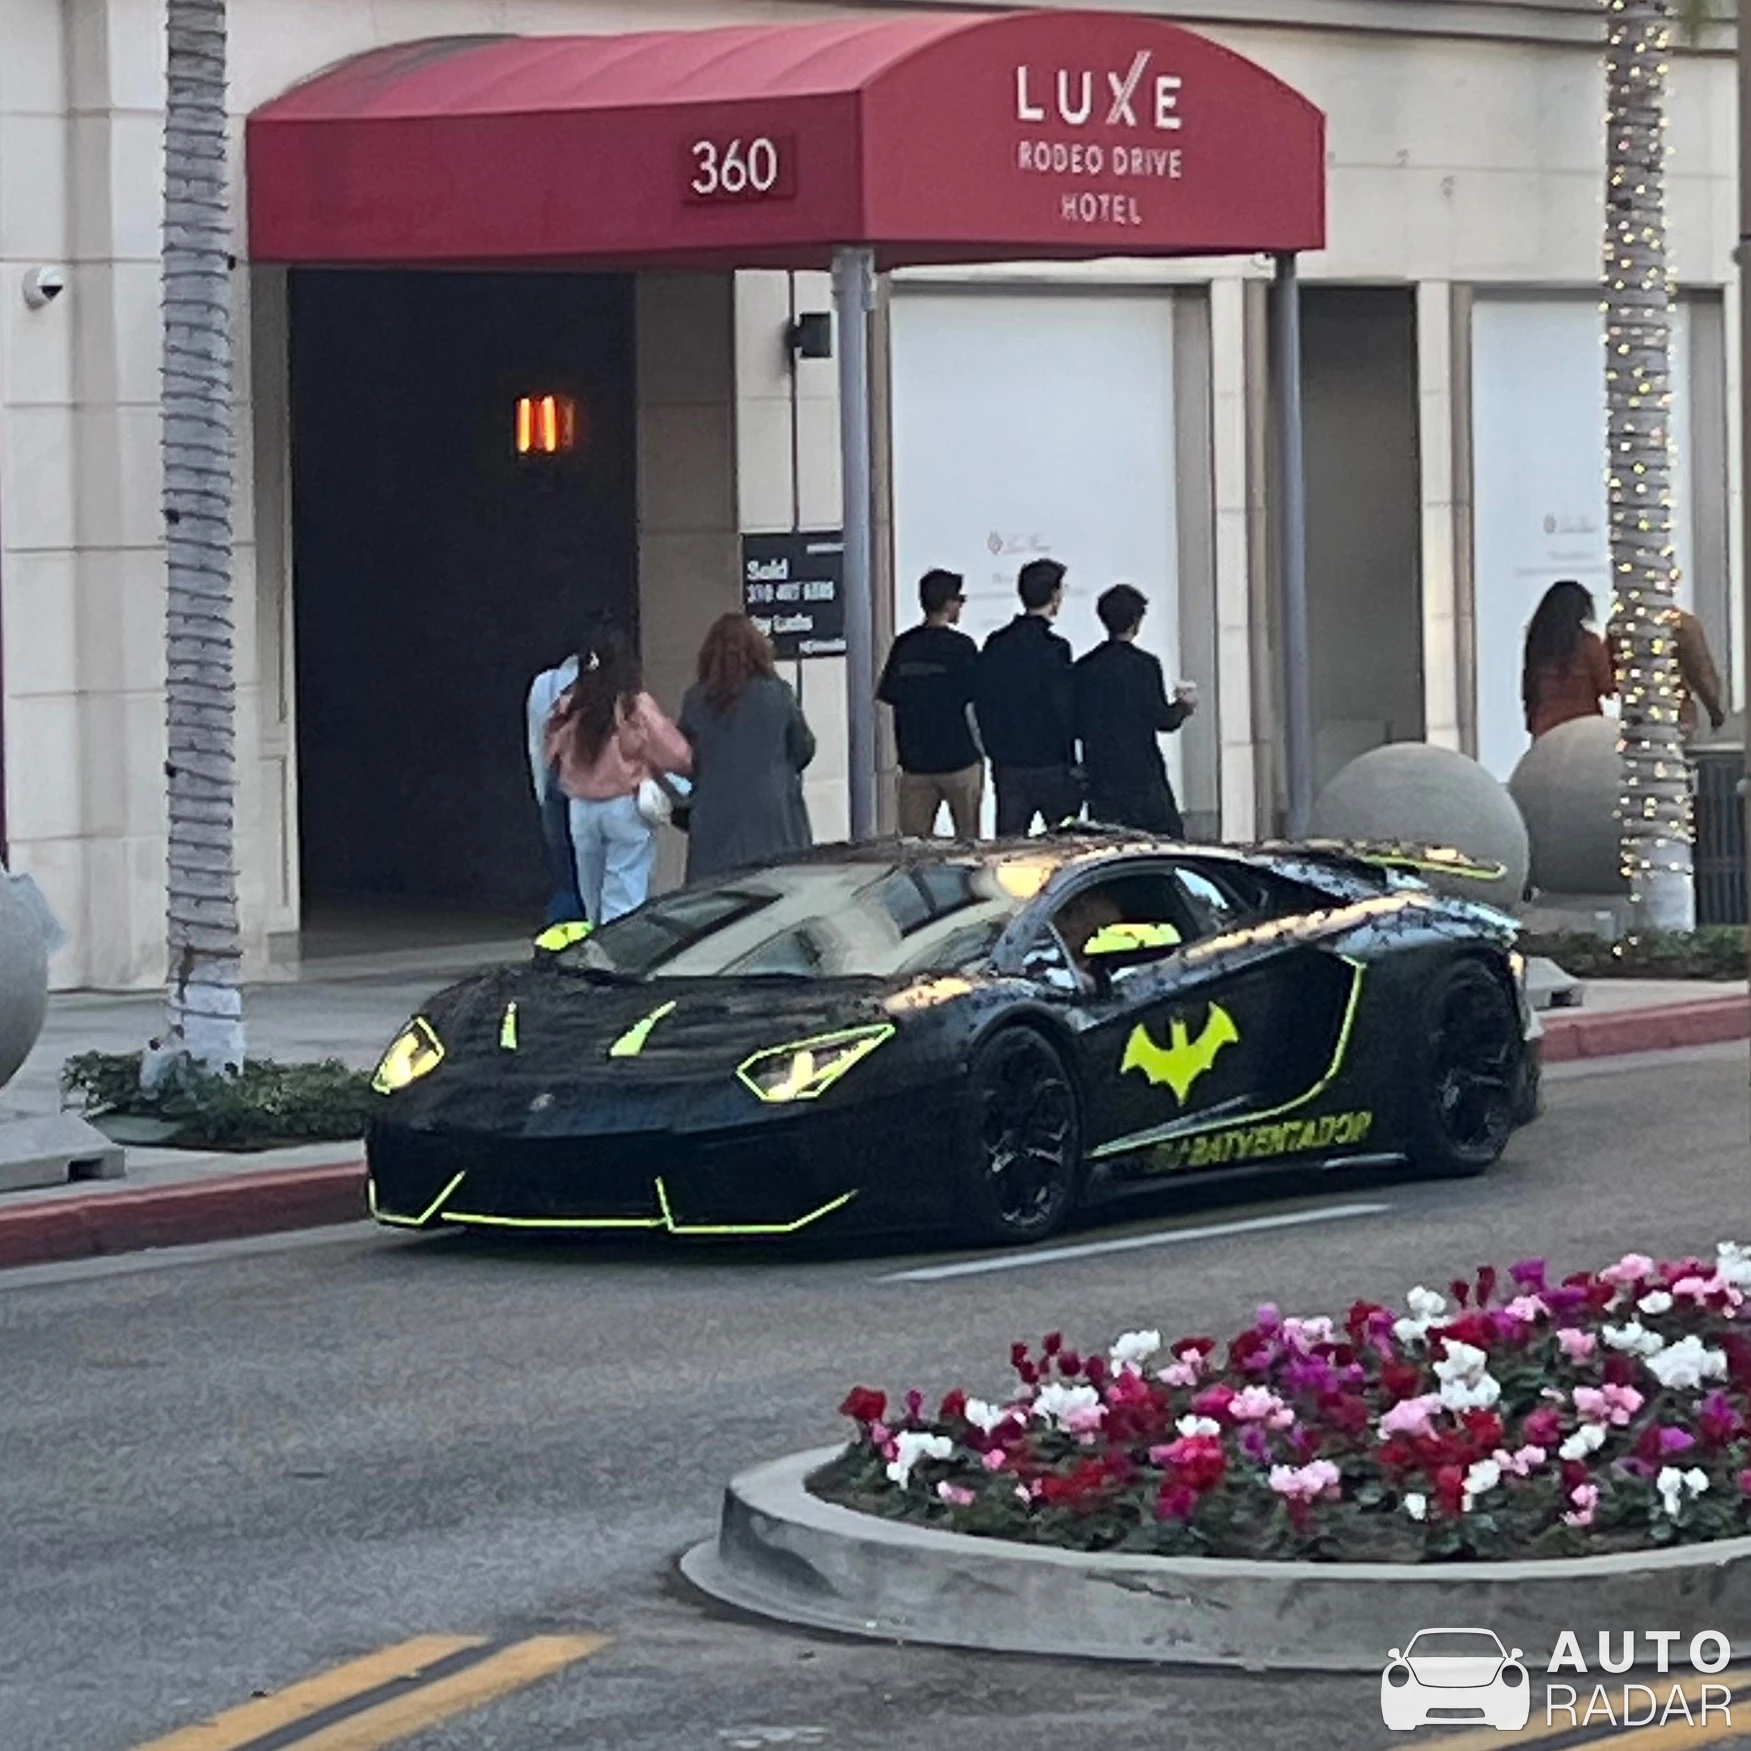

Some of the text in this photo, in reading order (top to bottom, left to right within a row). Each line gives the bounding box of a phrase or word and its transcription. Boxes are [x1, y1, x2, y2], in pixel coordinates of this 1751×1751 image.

[1017, 50, 1182, 130] LUXE
[692, 138, 777, 195] 360
[1018, 141, 1182, 178] RODEO DRIVE
[1062, 193, 1142, 226] HOTEL
